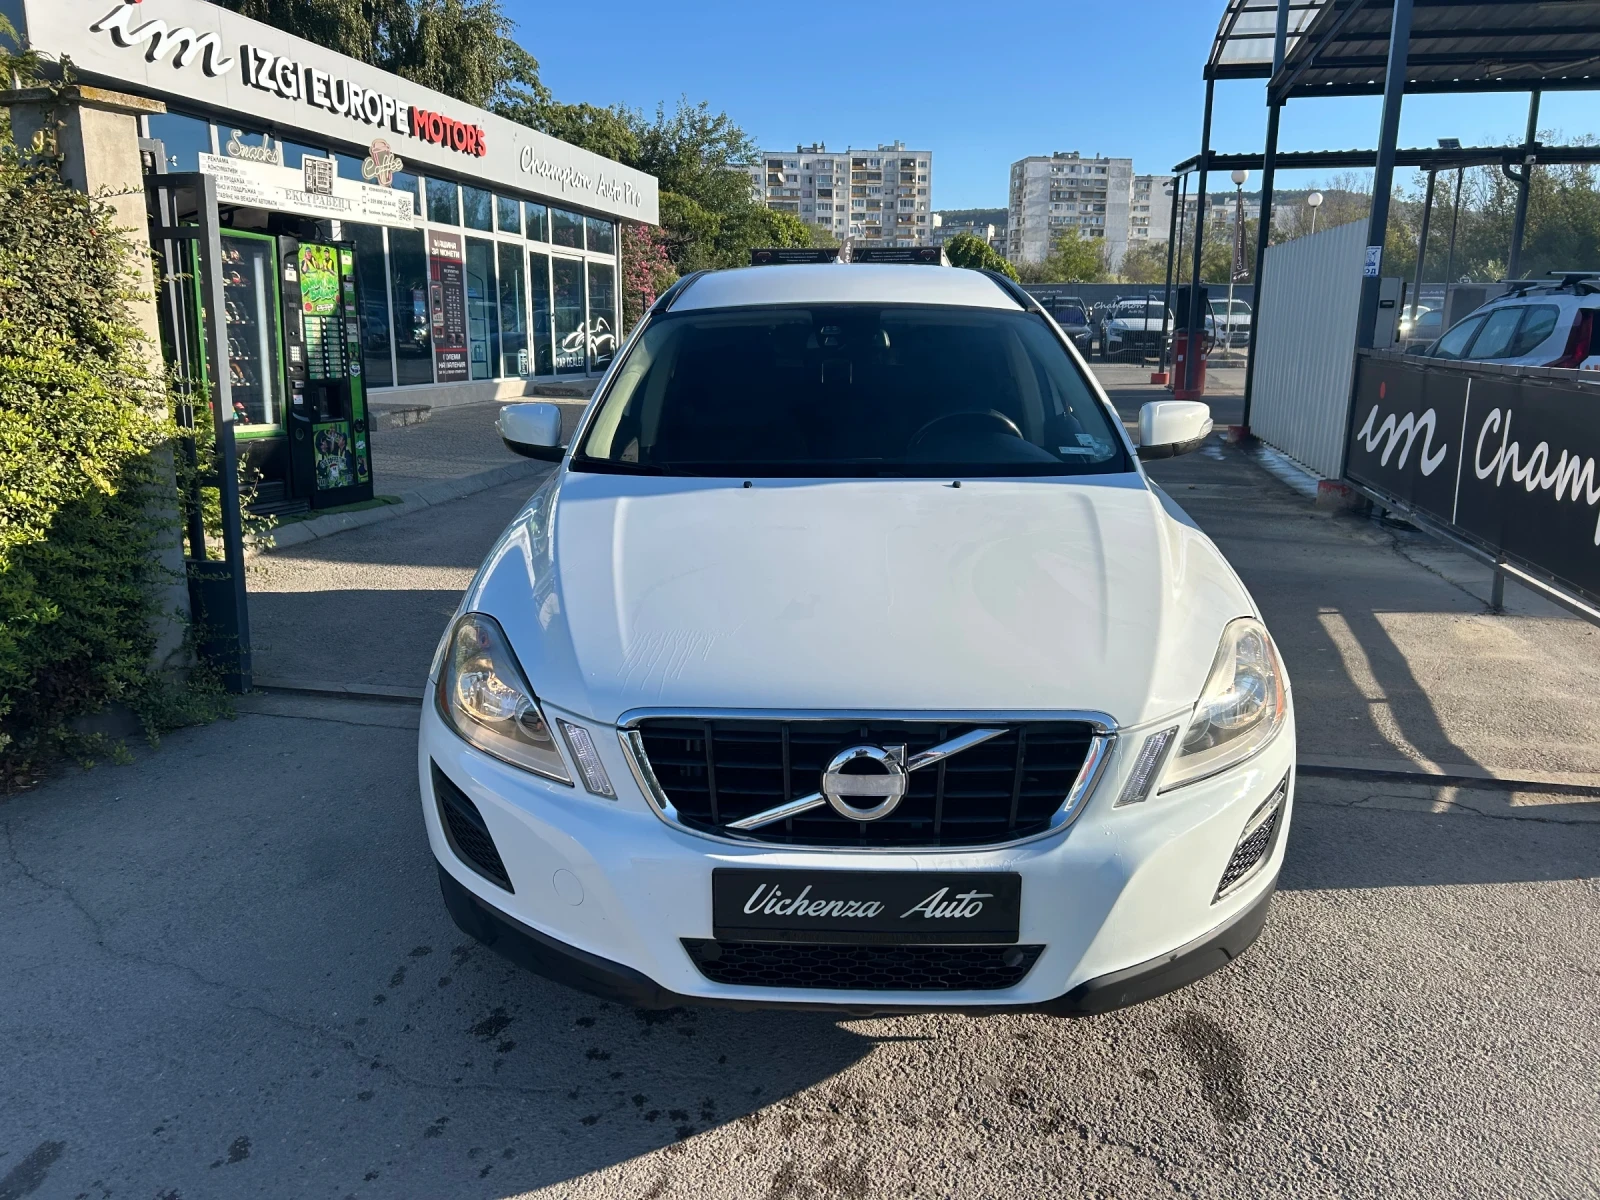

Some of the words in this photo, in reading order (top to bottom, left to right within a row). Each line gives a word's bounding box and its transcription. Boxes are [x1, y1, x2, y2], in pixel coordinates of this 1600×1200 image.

[241, 44, 303, 100] IZGI
[305, 67, 411, 135] EUROPE
[226, 129, 279, 165] Snacks
[362, 154, 403, 180] Coffee
[520, 145, 592, 192] Champion
[596, 173, 621, 202] Auto
[624, 181, 642, 207] Pro
[285, 188, 352, 212] ЕКСТРАВЕНД
[1357, 381, 1447, 477] im
[743, 883, 885, 917] Vichenza
[900, 886, 994, 918] Auto
